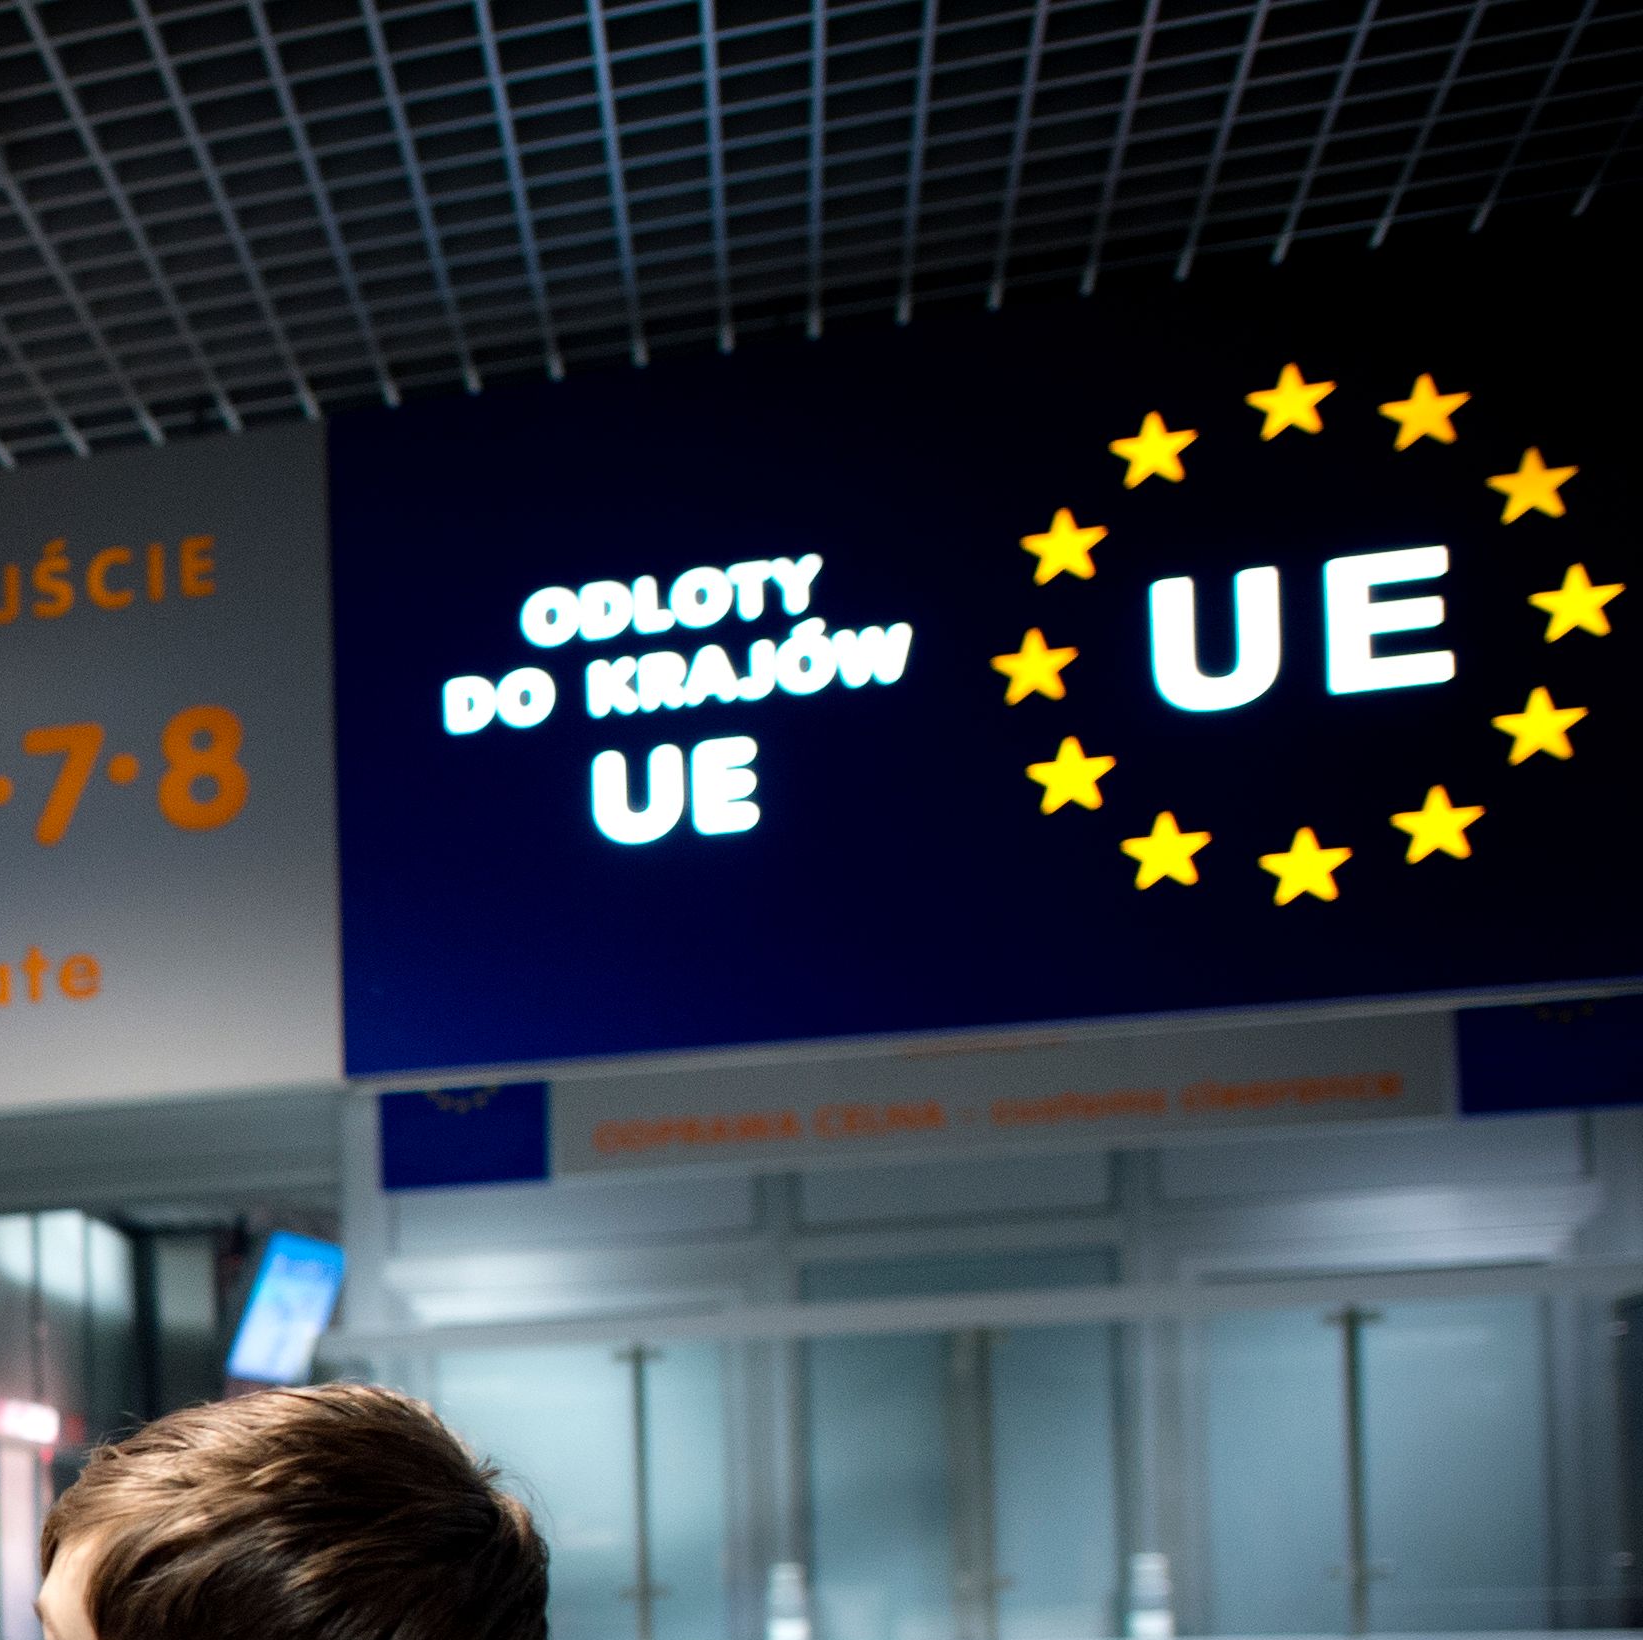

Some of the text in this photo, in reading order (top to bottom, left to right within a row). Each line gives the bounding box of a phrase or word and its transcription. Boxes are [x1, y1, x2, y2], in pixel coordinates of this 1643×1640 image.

[520, 553, 823, 648] ODLOTY
[1149, 544, 1457, 712] UE
[443, 617, 913, 735] DO KRAJÓW
[591, 736, 760, 844] UE
